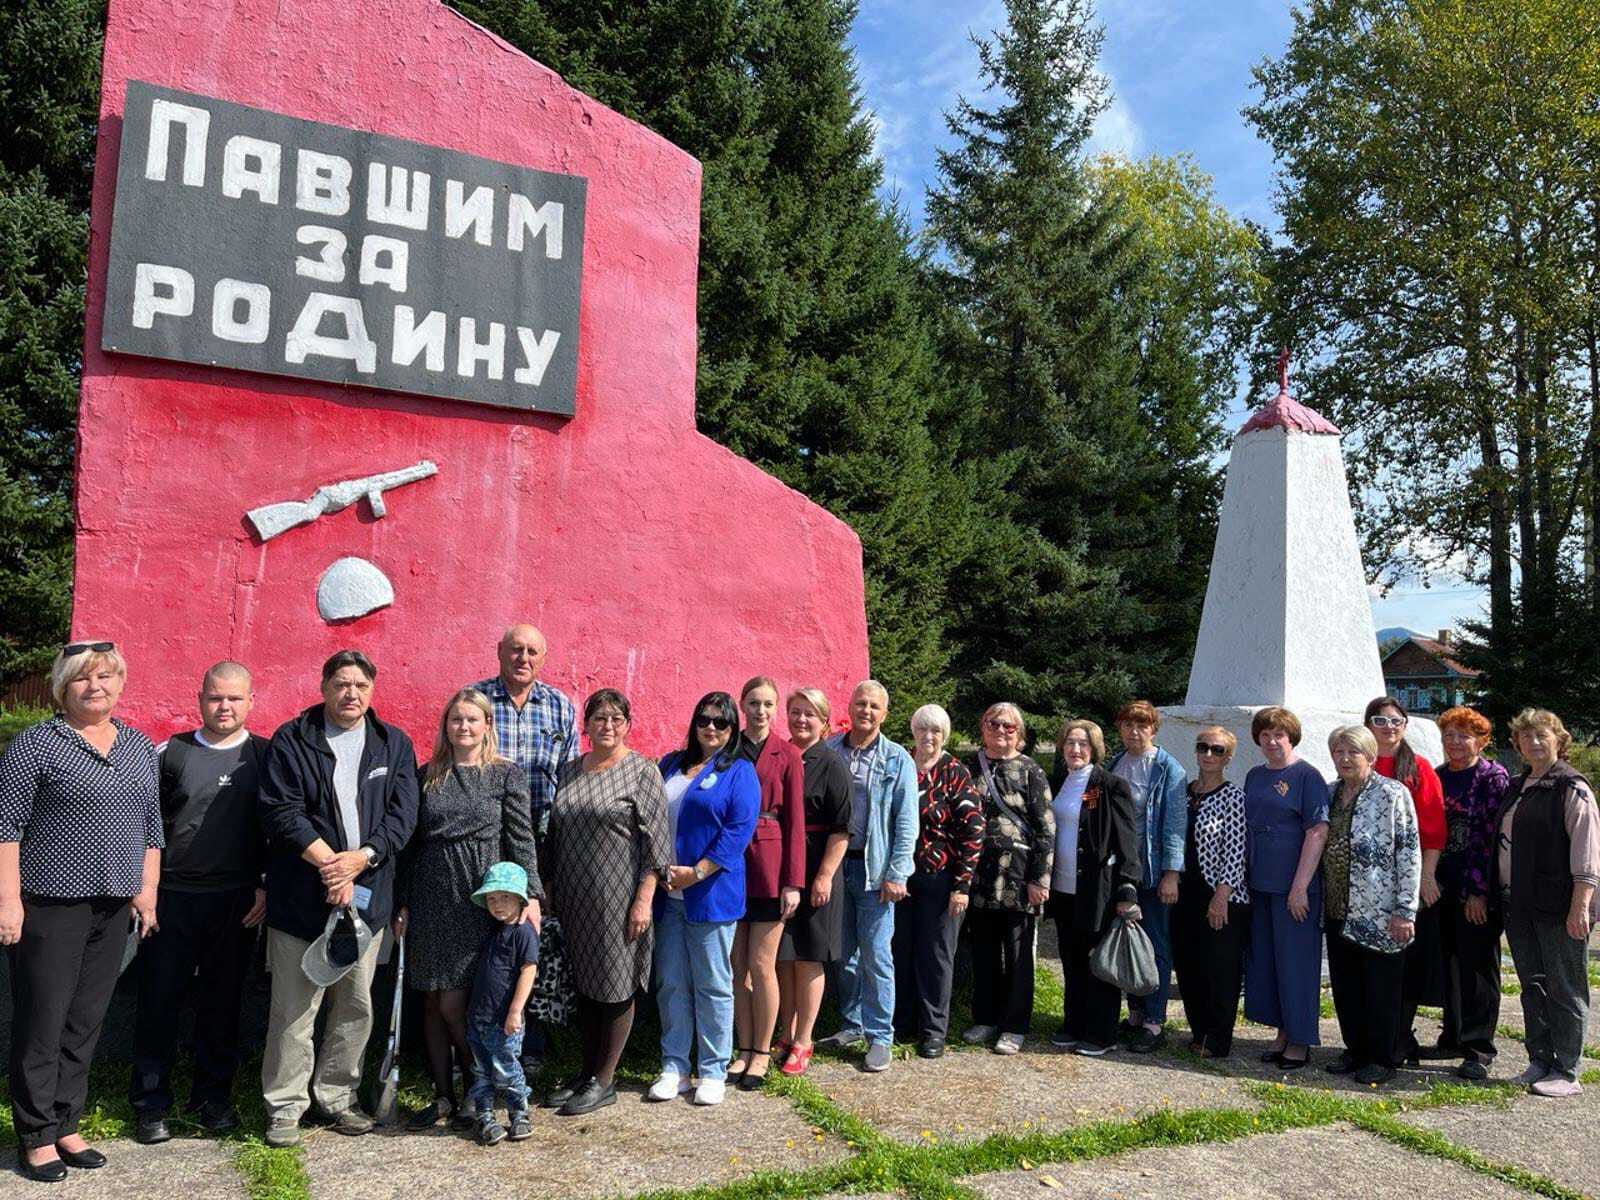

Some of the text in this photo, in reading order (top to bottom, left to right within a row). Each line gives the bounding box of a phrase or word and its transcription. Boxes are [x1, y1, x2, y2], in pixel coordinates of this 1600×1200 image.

[144, 98, 565, 260] ПАВШИМ
[295, 224, 409, 293] ЗА
[131, 262, 561, 387] РОДИНУ
